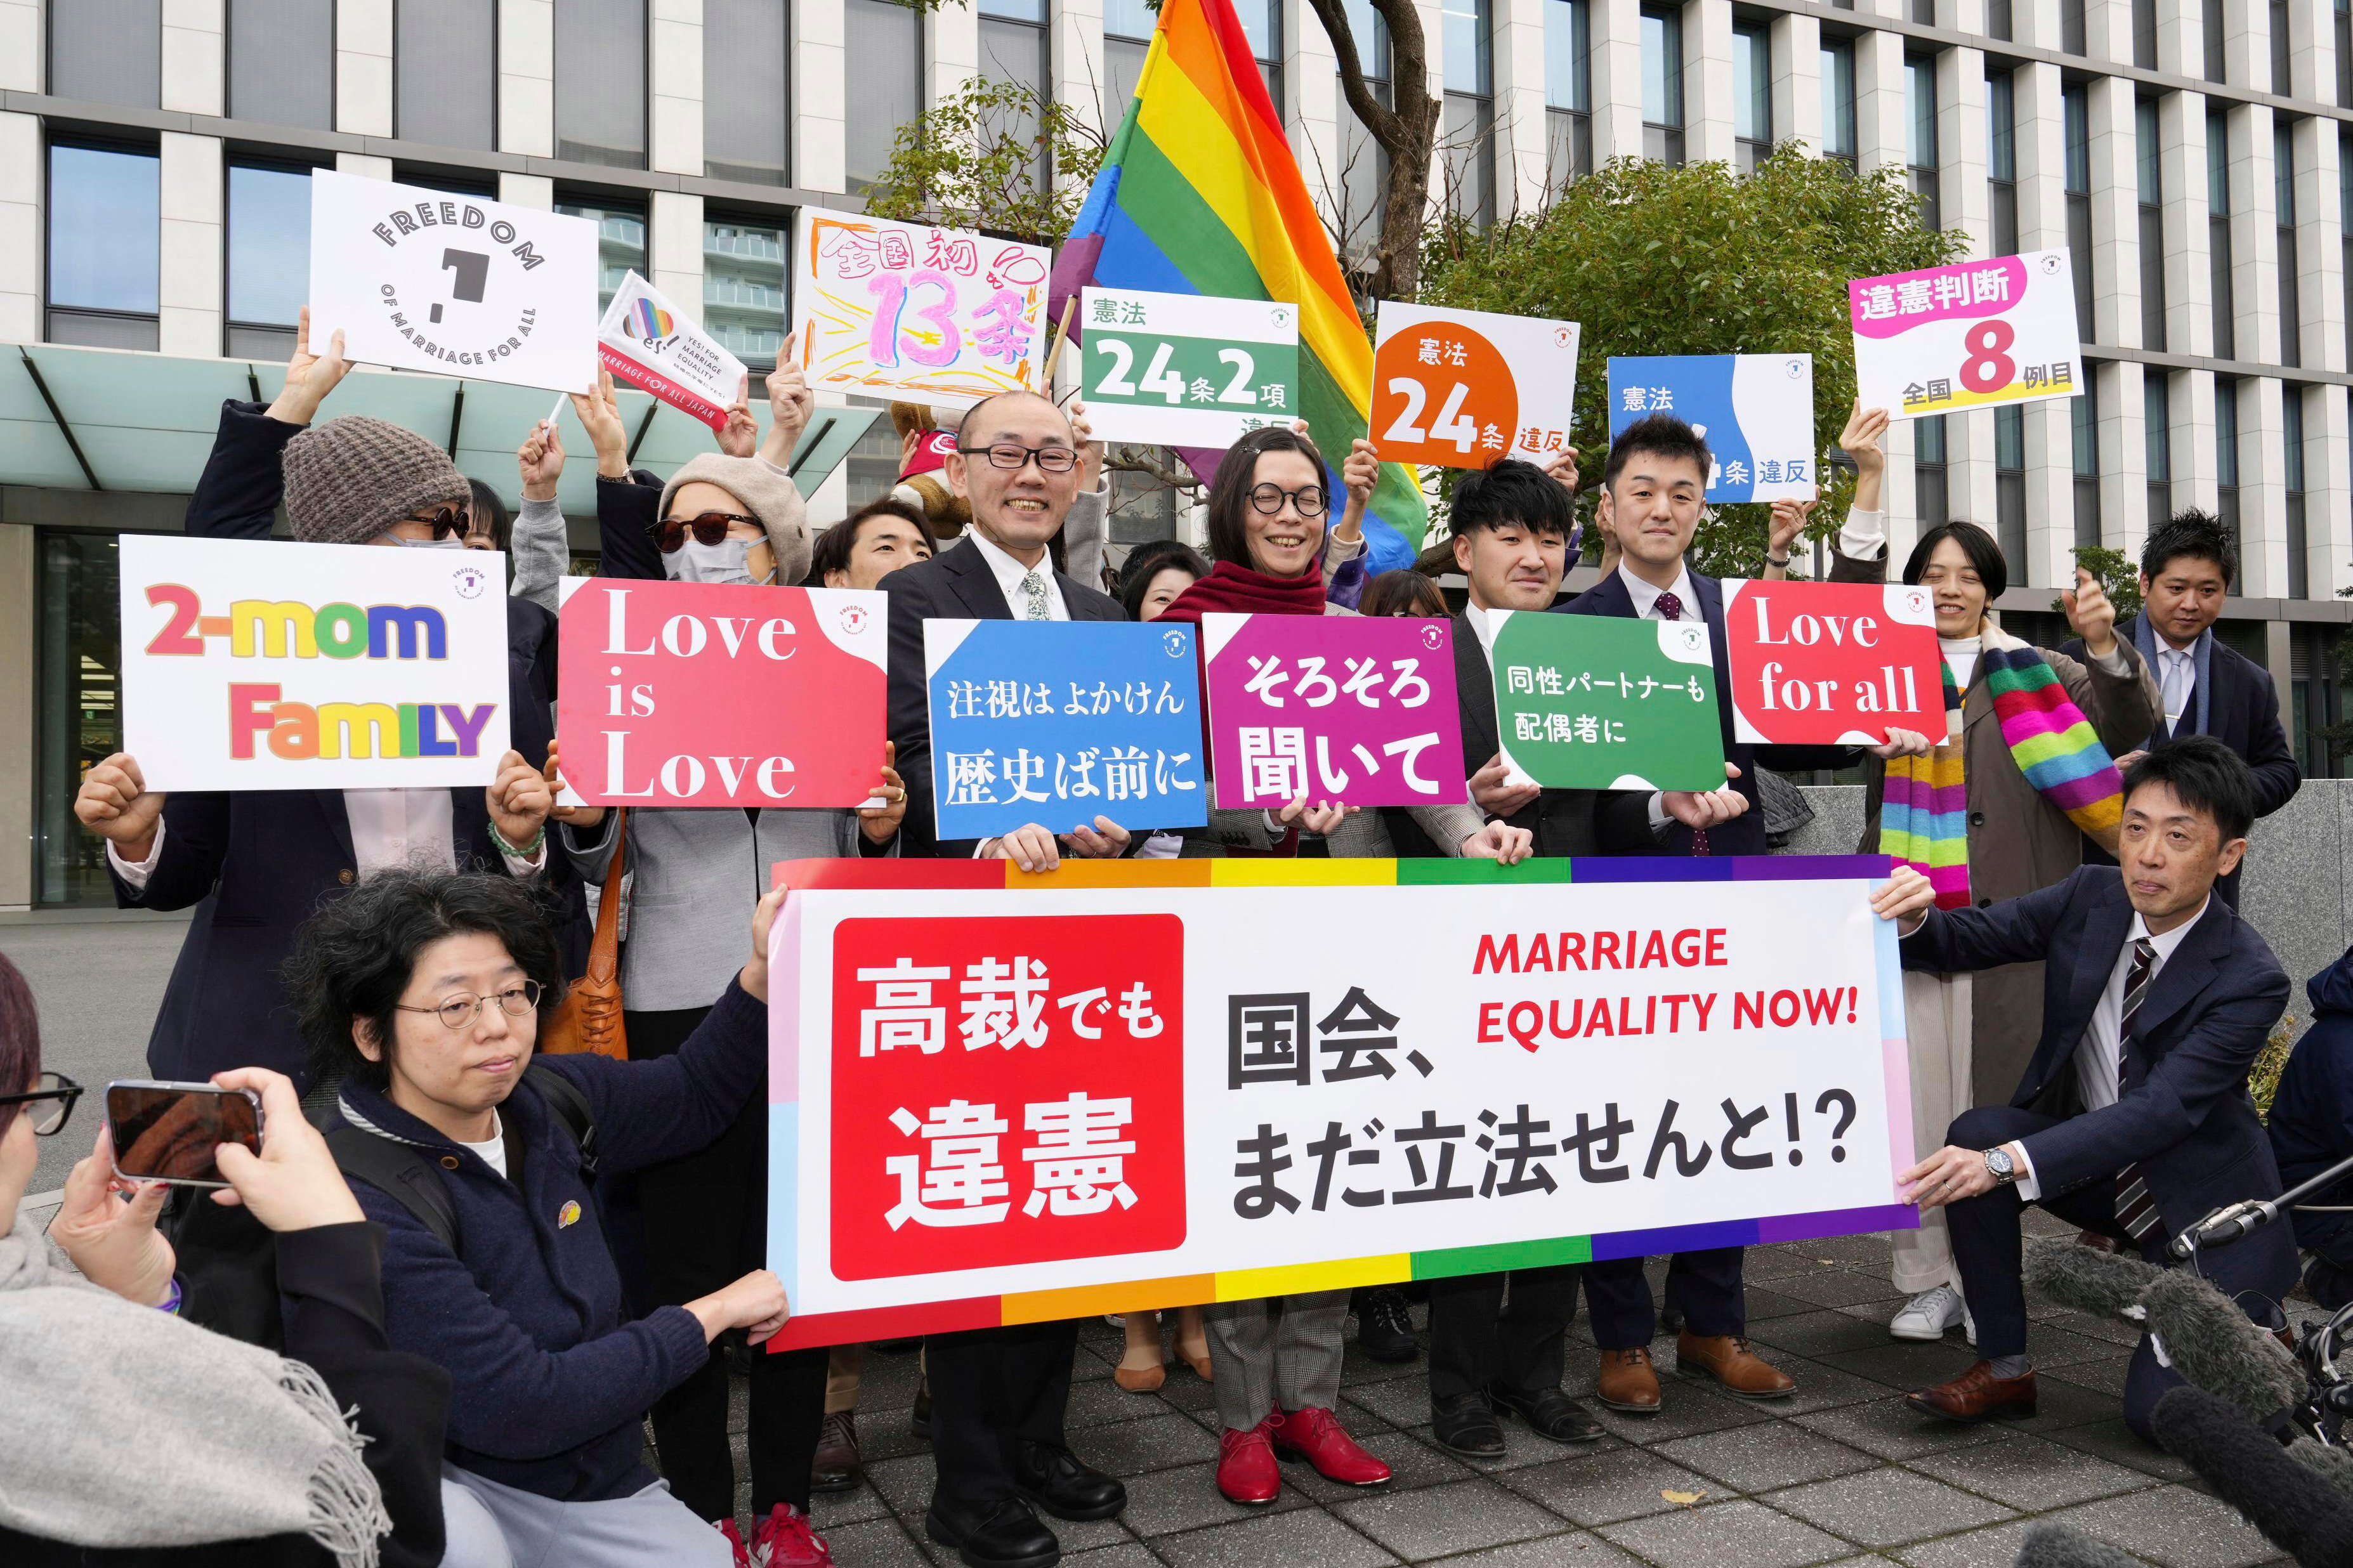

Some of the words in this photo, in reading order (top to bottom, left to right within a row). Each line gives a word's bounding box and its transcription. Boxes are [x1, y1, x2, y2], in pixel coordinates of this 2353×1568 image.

[372, 201, 546, 271] FREEDOM
[867, 269, 1036, 369] 13条
[1092, 297, 1146, 325] 憲法
[1859, 266, 2009, 321] 違憲判断
[381, 284, 398, 306] OF
[390, 311, 484, 365] MARRIAGE
[487, 337, 522, 362] FOR
[518, 308, 536, 337] ALL
[688, 336, 704, 351] YES!
[705, 348, 720, 362] FOR
[677, 353, 714, 381] EQUALITY
[682, 344, 723, 376] MARRIAGE
[1094, 338, 1287, 408] 24条2項
[1418, 337, 1468, 367] 憲法
[669, 387, 688, 403] ALL
[686, 399, 716, 419] JAPAN
[1623, 386, 1674, 412] 憲法
[452, 567, 486, 580] FREEDOM
[143, 582, 449, 661] 2-mom
[601, 587, 797, 661] Love
[839, 605, 868, 617] FREEDOM
[1162, 630, 1187, 641] FREEDOM
[1420, 624, 1443, 634] FREEDOM
[1751, 596, 1878, 647] Love
[605, 665, 655, 717] is
[1244, 655, 1430, 709] そろそろ
[1507, 665, 1705, 702] 同性パートナーも
[1760, 662, 1838, 712] for
[1855, 665, 1922, 714] all
[1514, 712, 1627, 744] 配偶者に
[599, 730, 796, 799] Love
[944, 745, 1198, 806] 歴史ば前に
[1238, 726, 1441, 803] 聞いて
[1472, 928, 1728, 975] MARRIAGE
[856, 956, 1165, 1057] 高裁でも
[1477, 993, 1717, 1054] EQUALITY
[1733, 986, 1858, 1030] NOW!
[1228, 986, 1434, 1090] 国会、
[884, 1092, 1139, 1232] 違憲
